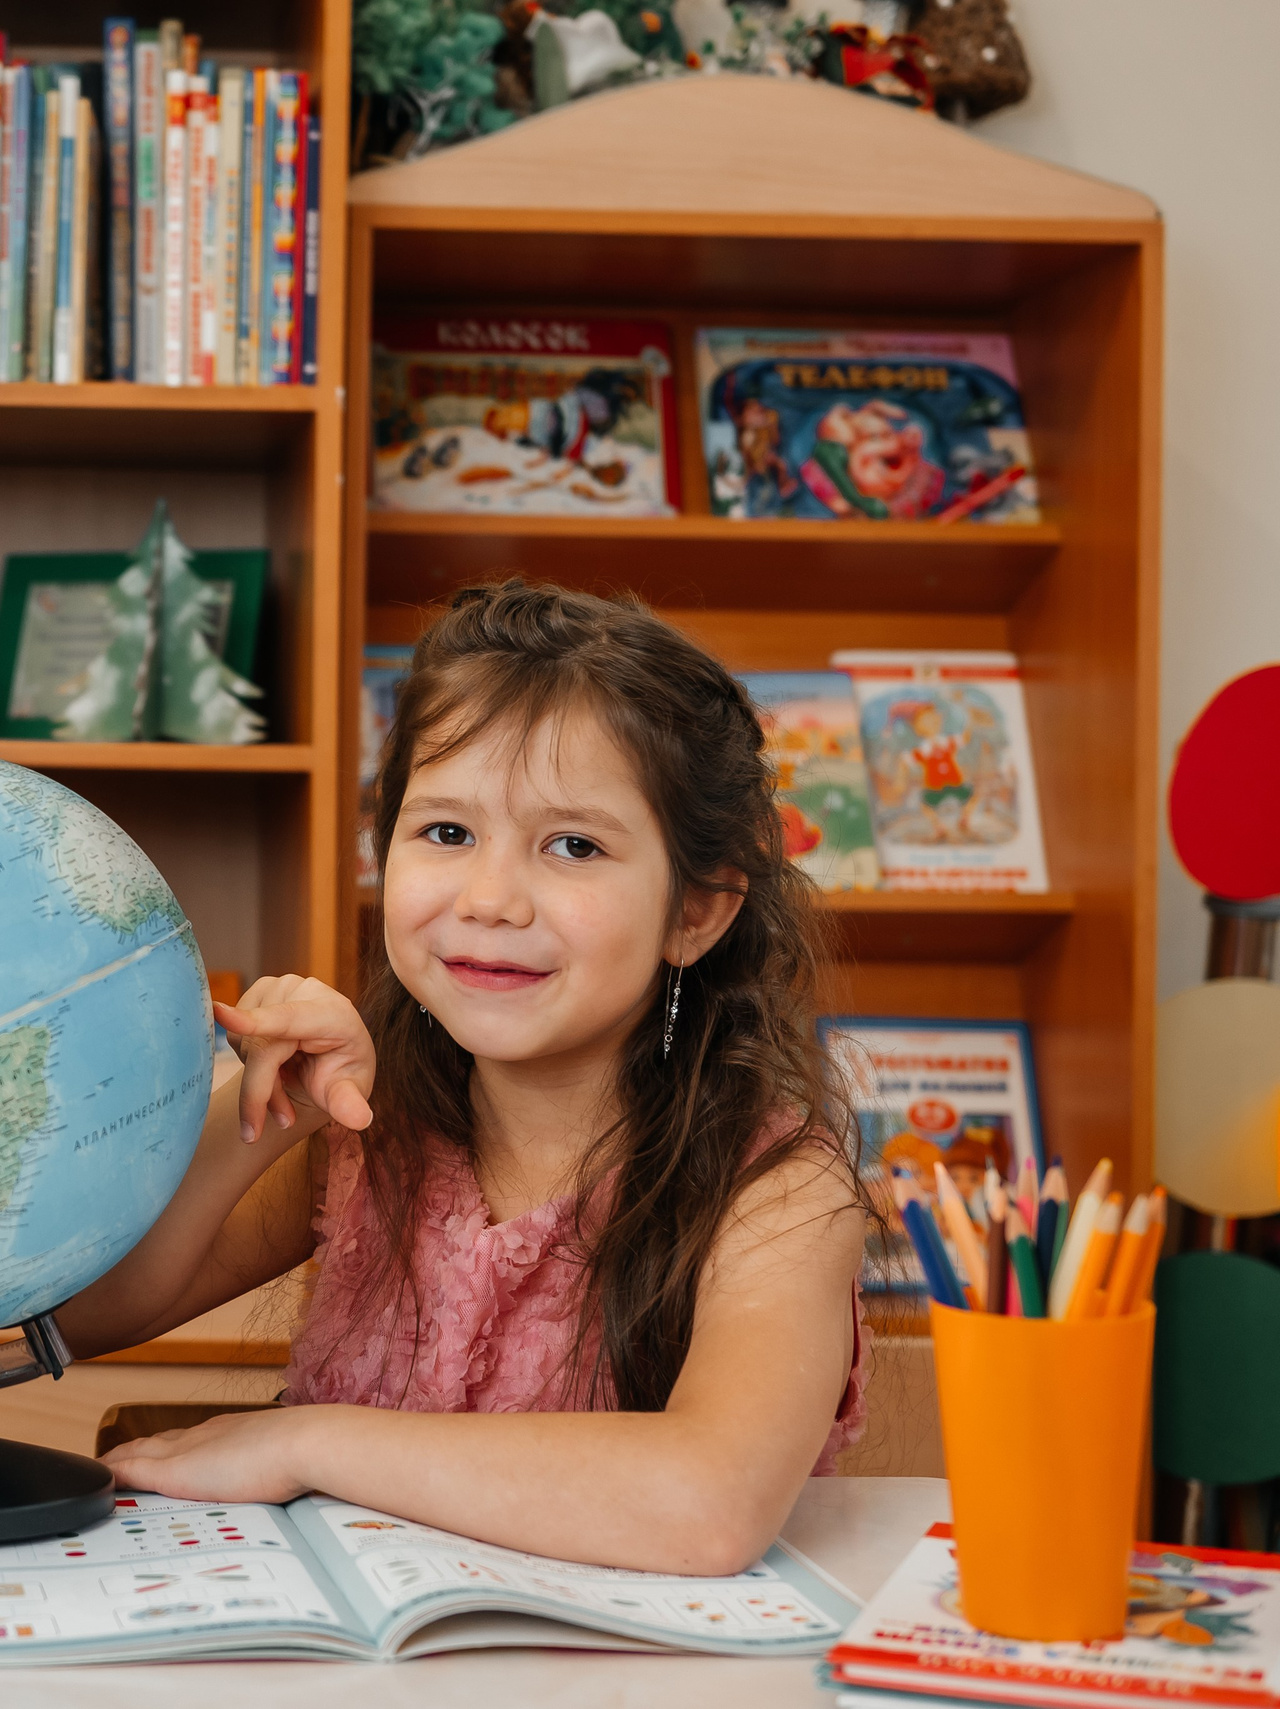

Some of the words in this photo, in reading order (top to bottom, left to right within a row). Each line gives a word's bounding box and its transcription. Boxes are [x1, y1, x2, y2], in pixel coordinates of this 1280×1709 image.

[436, 321, 591, 350] КОЛОСОК
[776, 364, 948, 391] ТЕЛЕФОН
[73, 1088, 175, 1152] АТЛАНТИЧЕСКИЙ
